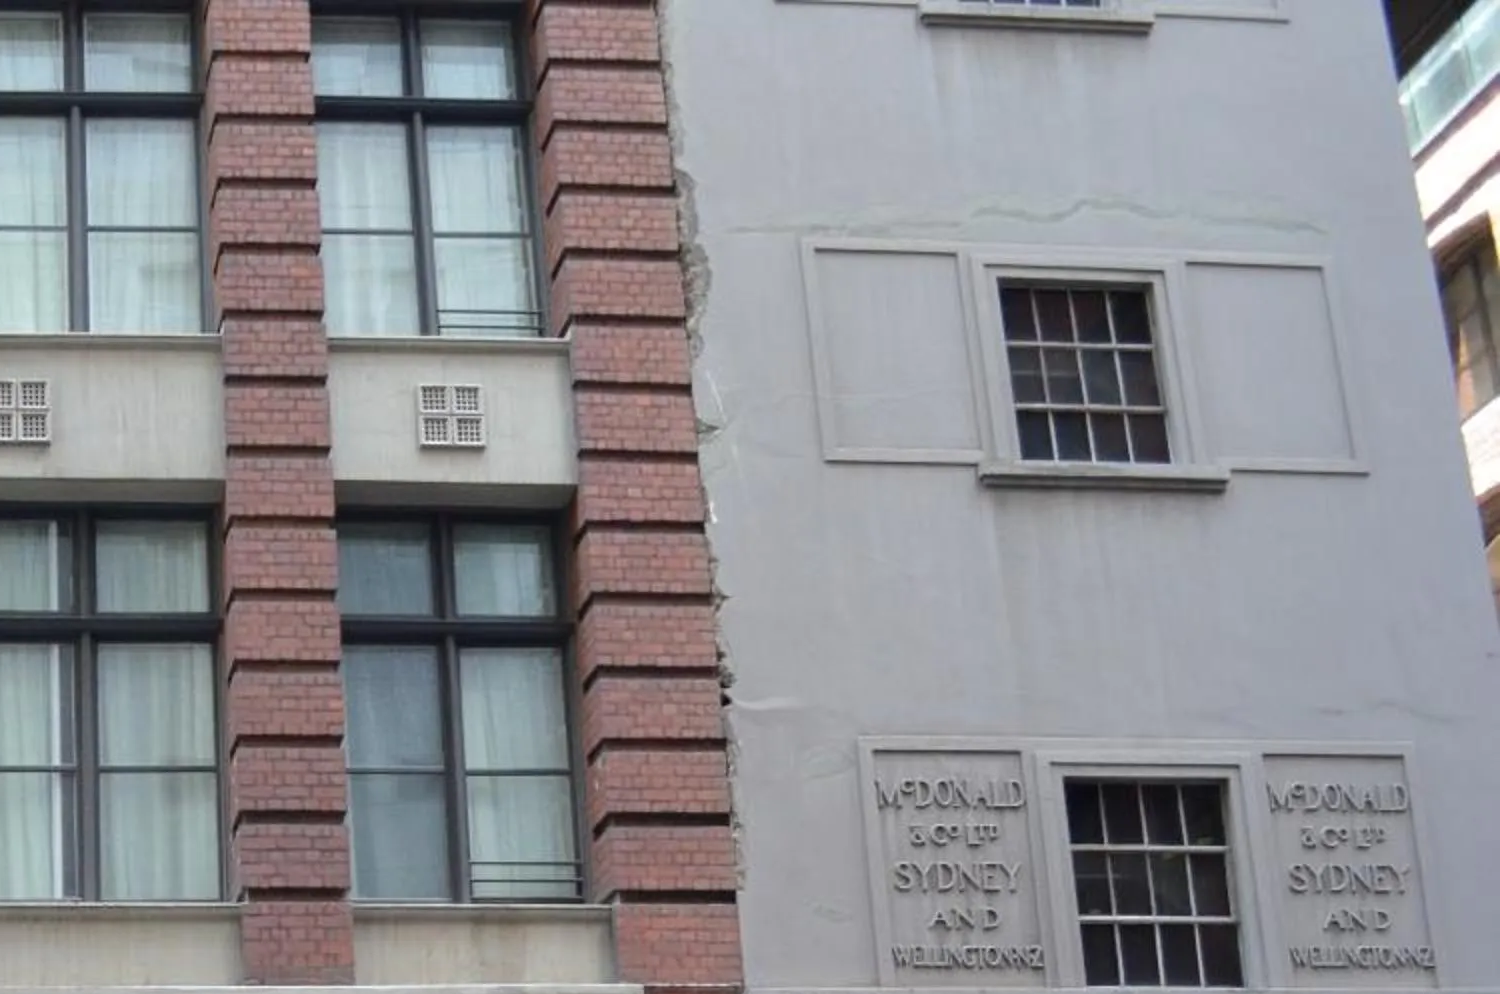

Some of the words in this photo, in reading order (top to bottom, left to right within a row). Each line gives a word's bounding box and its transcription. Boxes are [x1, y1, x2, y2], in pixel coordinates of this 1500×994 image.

[894, 861, 1022, 894] SYDNEY
[1288, 863, 1411, 895] SYDNEY
[928, 905, 1001, 932] AND
[1322, 908, 1392, 933] AND
